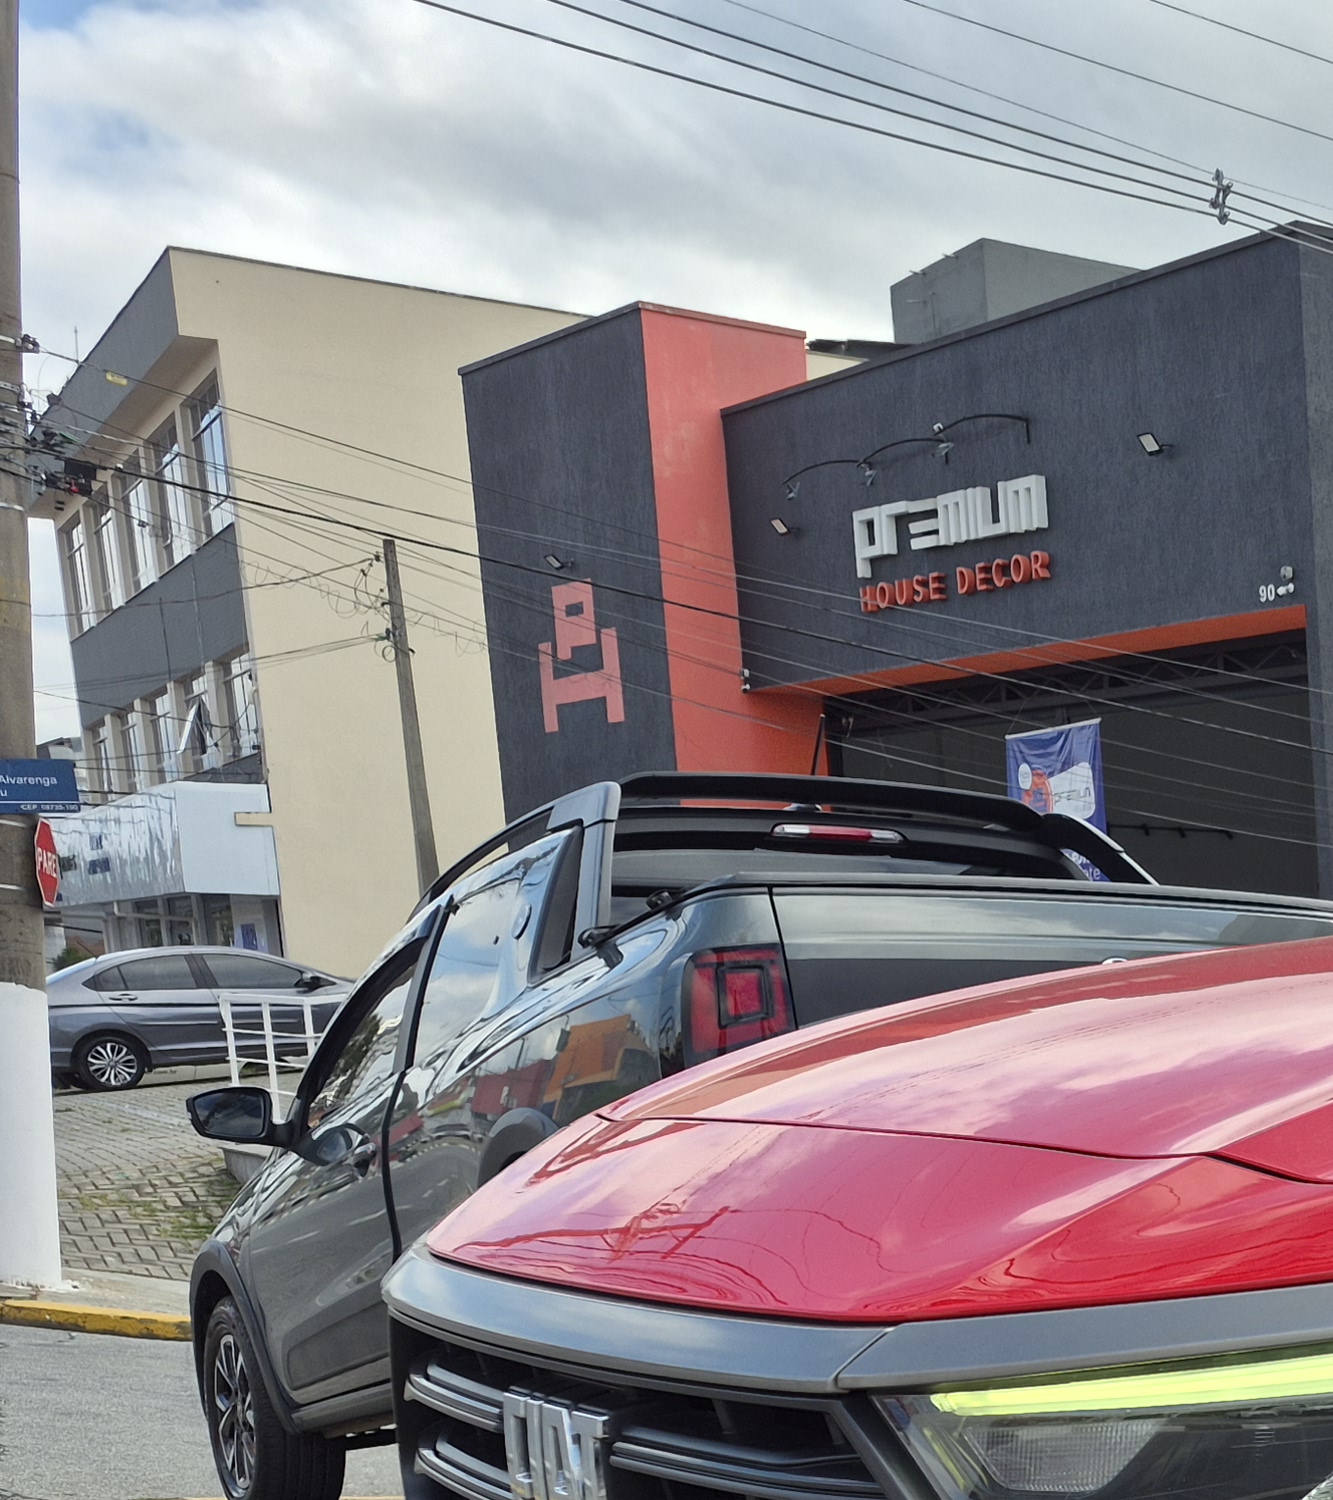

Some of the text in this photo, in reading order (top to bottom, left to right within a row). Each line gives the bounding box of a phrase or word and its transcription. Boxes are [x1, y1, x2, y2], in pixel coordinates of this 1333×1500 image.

[859, 551, 1050, 612] HOUSE DECOR
[1258, 584, 1275, 603] 90
[37, 846, 58, 879] PARE
